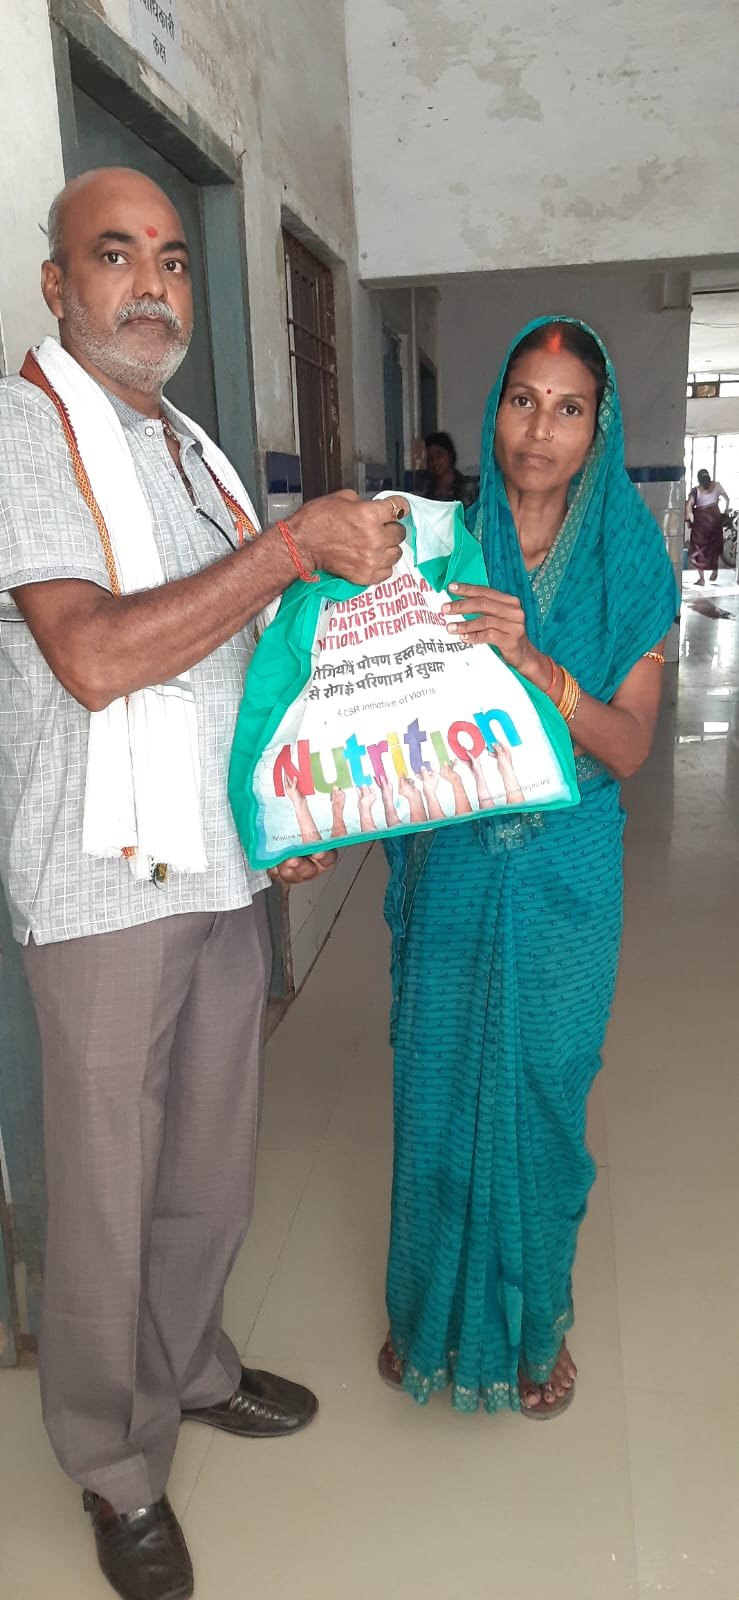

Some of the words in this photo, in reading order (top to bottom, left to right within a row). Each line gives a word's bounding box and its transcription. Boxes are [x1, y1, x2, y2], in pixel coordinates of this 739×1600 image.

[376, 591, 428, 617] THROUG
[309, 685, 321, 700] से
[323, 683, 344, 698] रोग
[344, 681, 355, 696] के
[356, 672, 403, 690] परिणाम
[404, 663, 414, 678] में
[414, 661, 446, 679] सुधार
[343, 705, 360, 716] CSR
[398, 694, 408, 704] of
[273, 708, 523, 797] Nutrition
